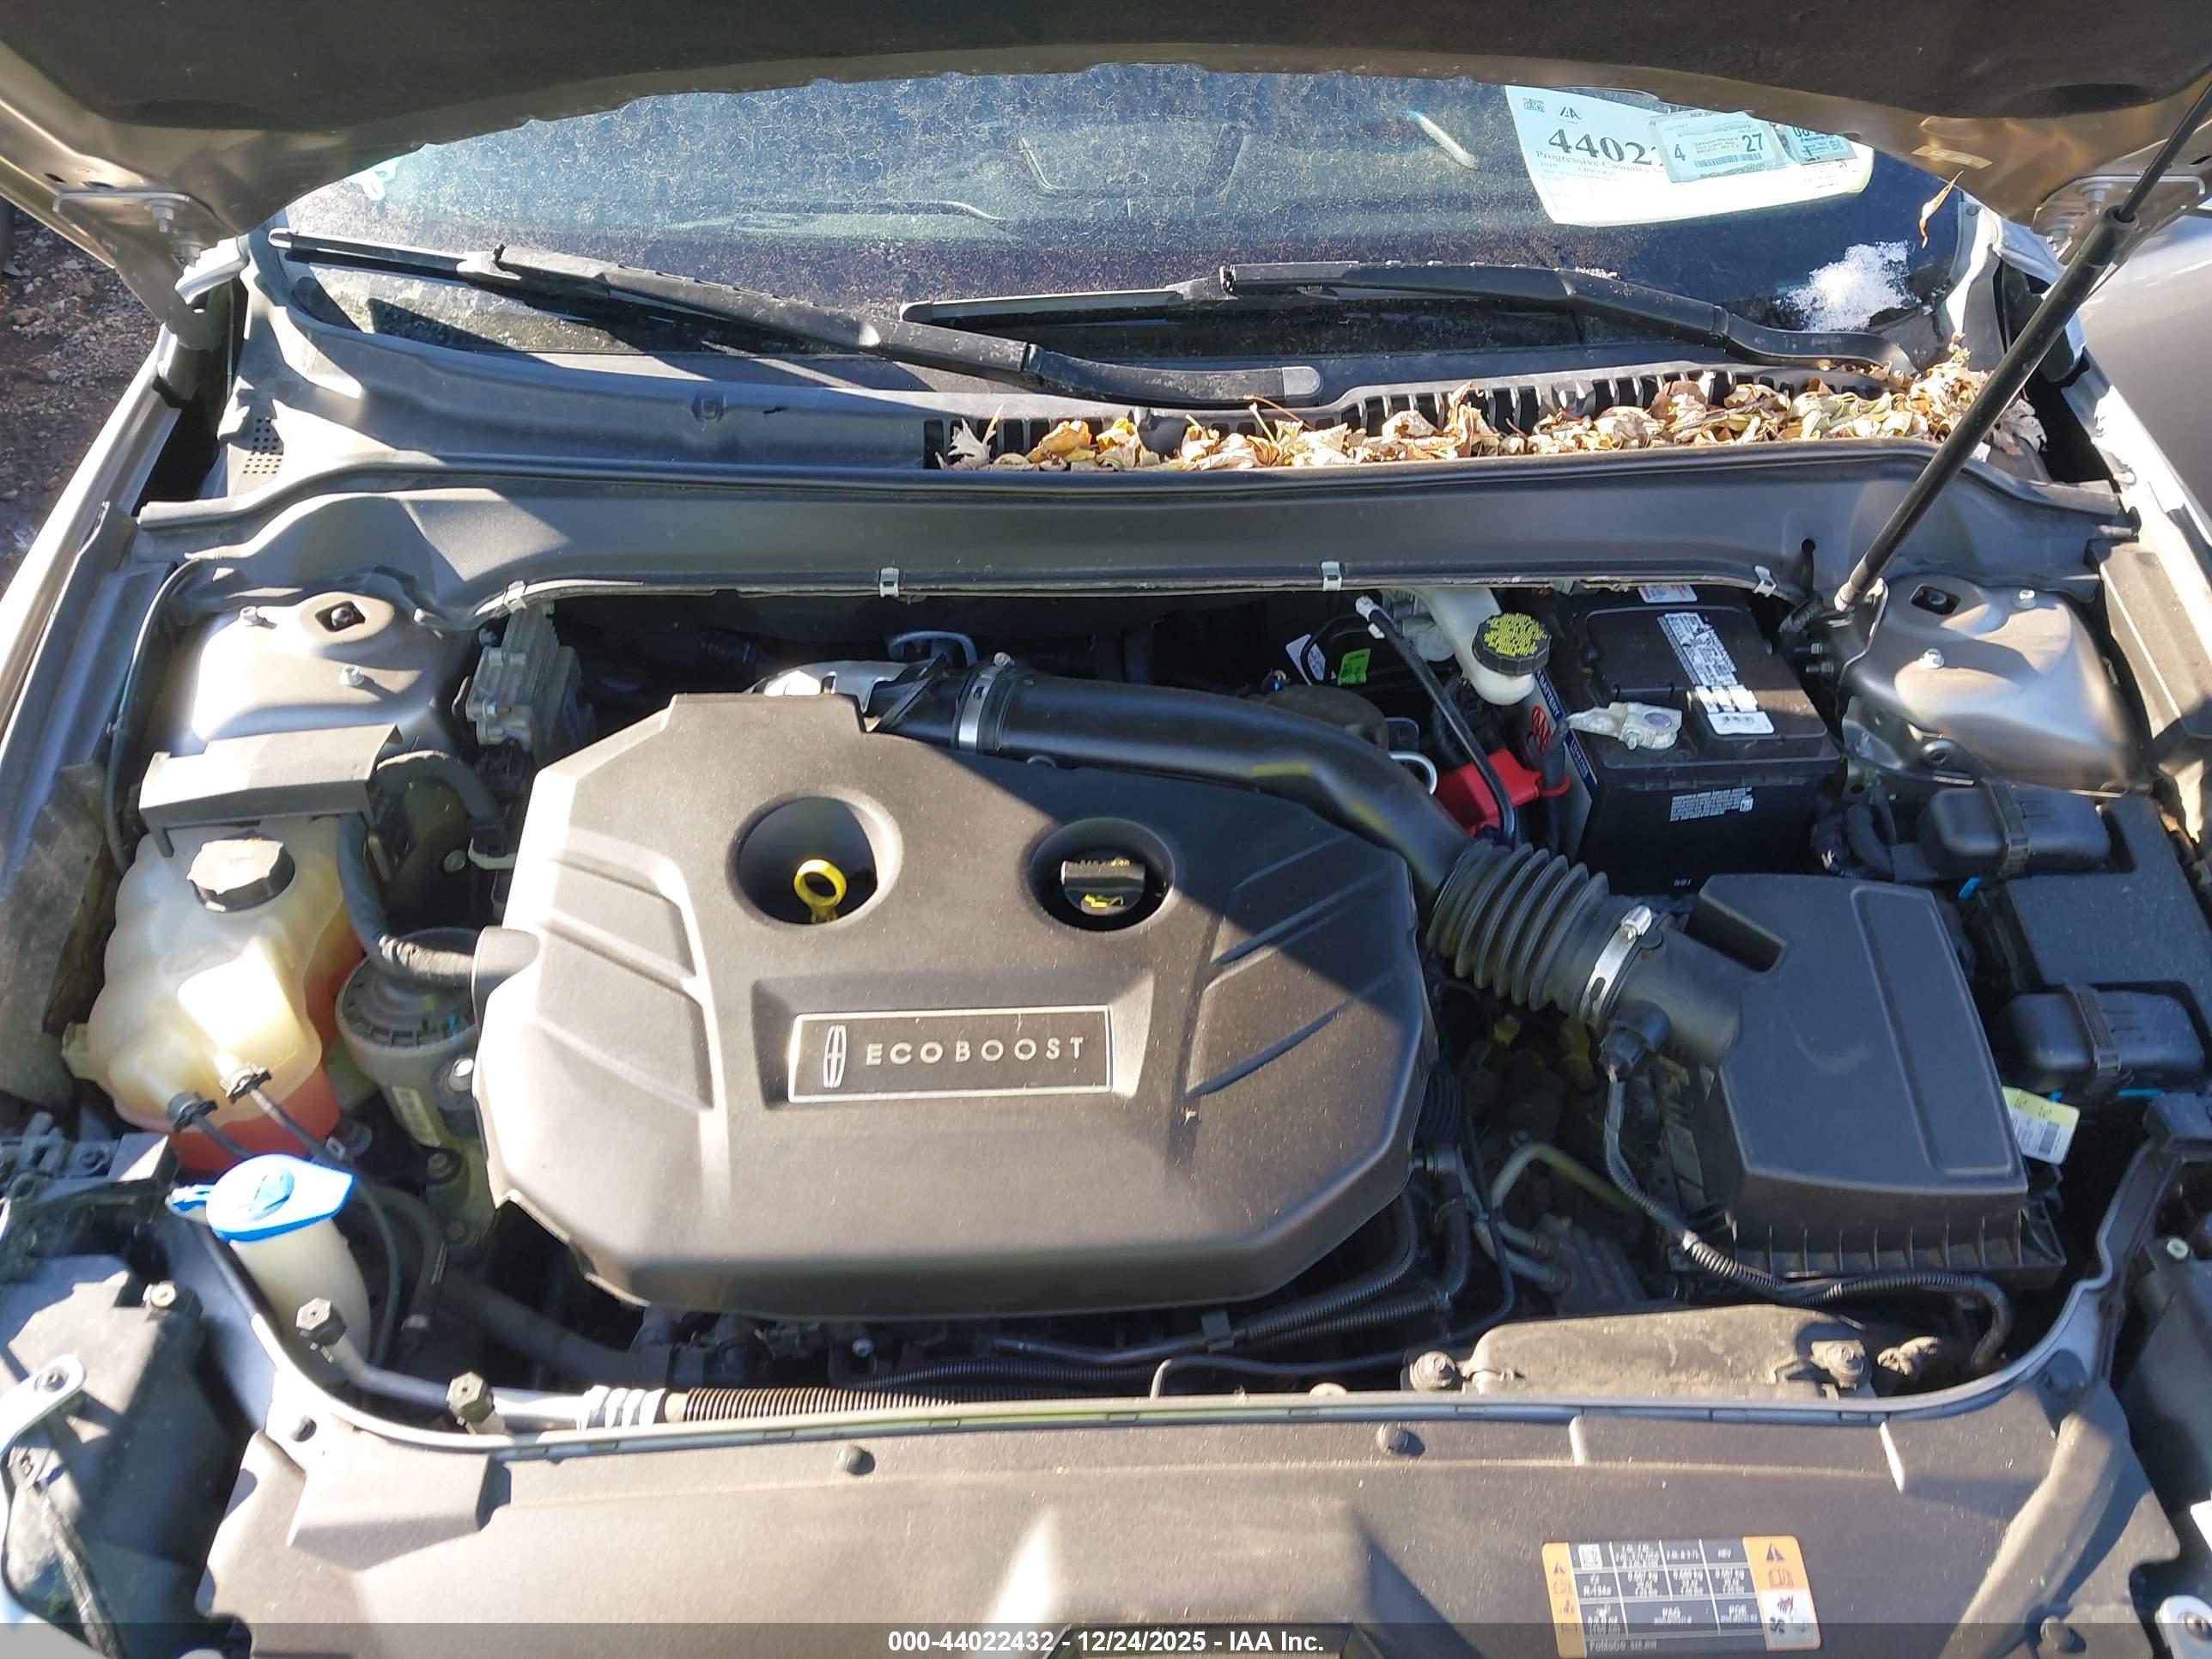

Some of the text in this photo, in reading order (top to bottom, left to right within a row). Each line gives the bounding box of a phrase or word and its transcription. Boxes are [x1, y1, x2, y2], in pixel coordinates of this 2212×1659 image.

[1674, 143, 1686, 161] 4
[1741, 132, 1763, 153] 27
[1536, 150, 1600, 167] Progressive
[866, 1036, 1084, 1066] ECOBOOST
